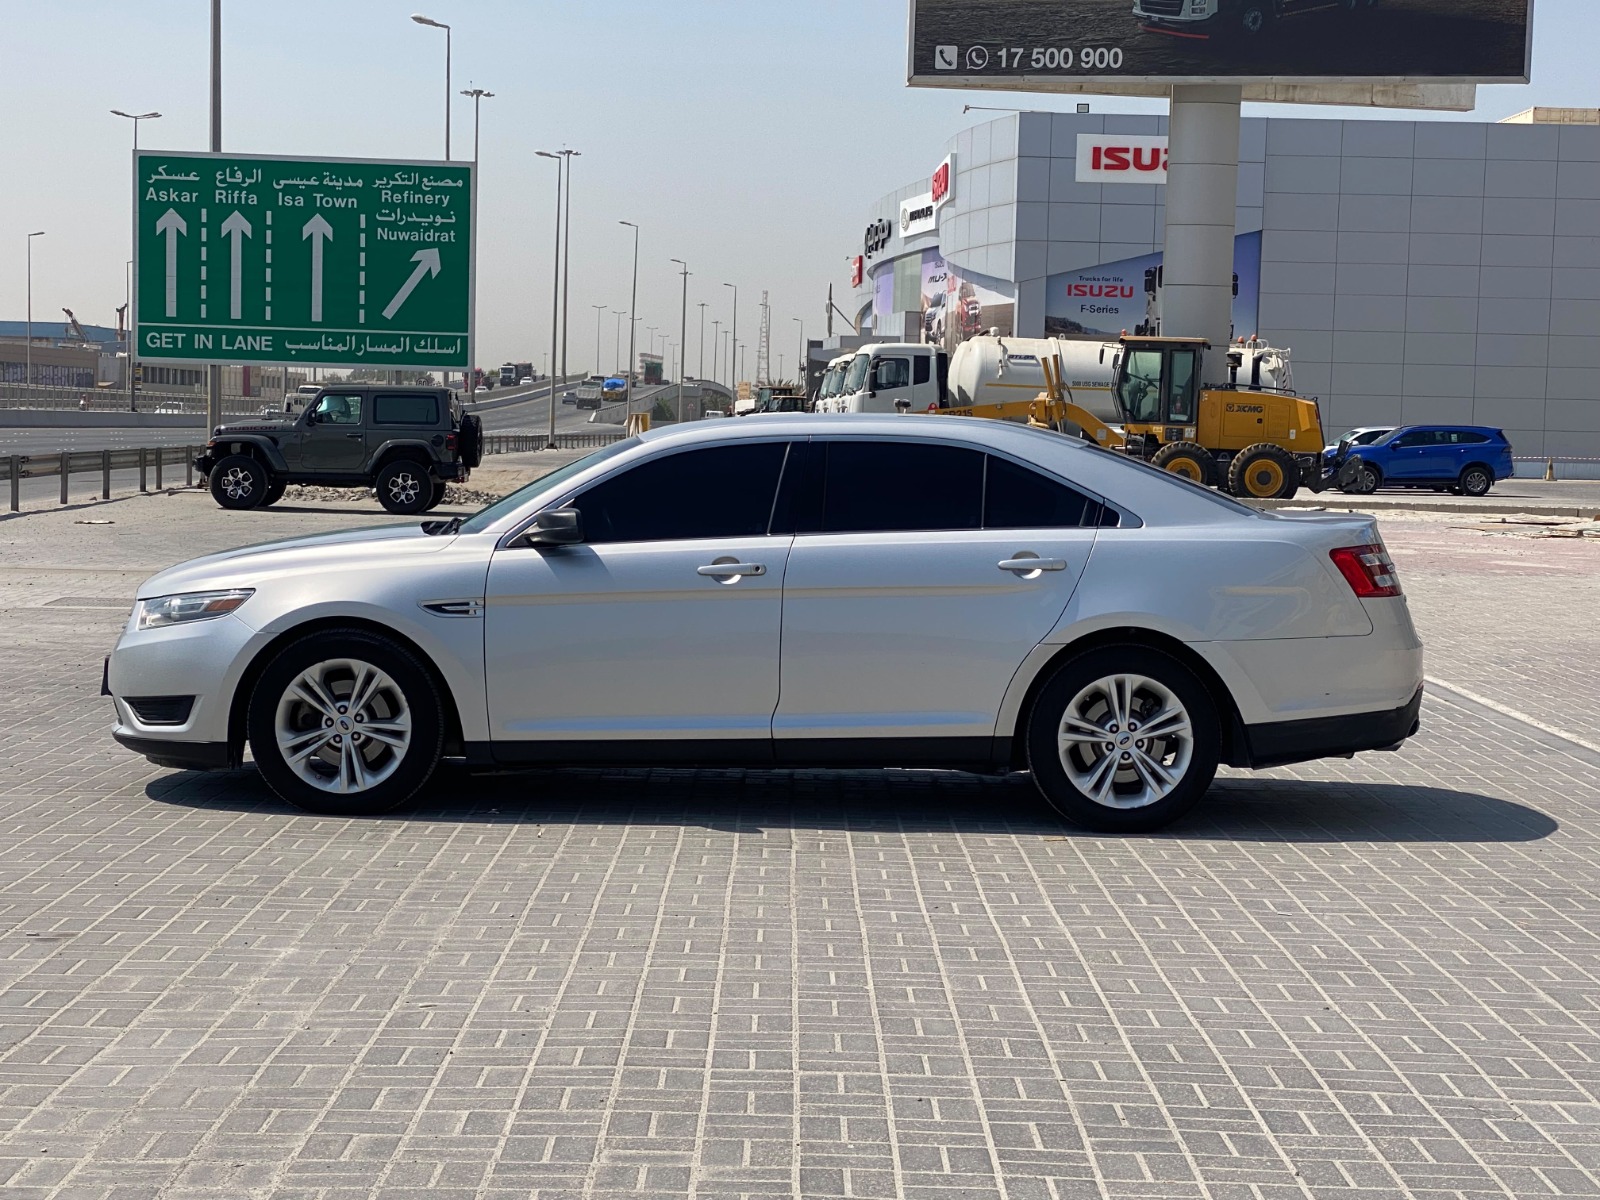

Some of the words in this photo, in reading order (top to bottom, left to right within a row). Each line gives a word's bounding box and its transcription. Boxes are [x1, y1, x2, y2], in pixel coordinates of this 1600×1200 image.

[997, 48, 1024, 68] 17
[1030, 48, 1073, 69] 500
[1080, 48, 1123, 69] 900
[1092, 147, 1168, 171] ISU
[146, 165, 200, 184] عسكر
[215, 166, 262, 187] الرفاع
[273, 176, 319, 189] عيسى
[323, 171, 363, 190] مدينة
[371, 171, 419, 188] التكرير
[421, 176, 463, 190] مصنع
[145, 187, 199, 203] Askar
[215, 190, 257, 205] Riffa
[278, 191, 304, 206] Isa
[312, 193, 357, 208] Town
[381, 190, 450, 207] Refinery
[375, 207, 456, 226] نويدرات
[377, 227, 456, 242] Nuwaidrat
[1067, 284, 1134, 298] ISUZU
[1080, 304, 1119, 314] F-Series
[145, 332, 187, 349] GET
[193, 333, 213, 350] IN
[221, 334, 273, 351] LANE
[284, 334, 356, 355] المناسب
[355, 335, 410, 356] المسار
[413, 338, 461, 354] اسلك
[1235, 405, 1264, 414] XCMG
